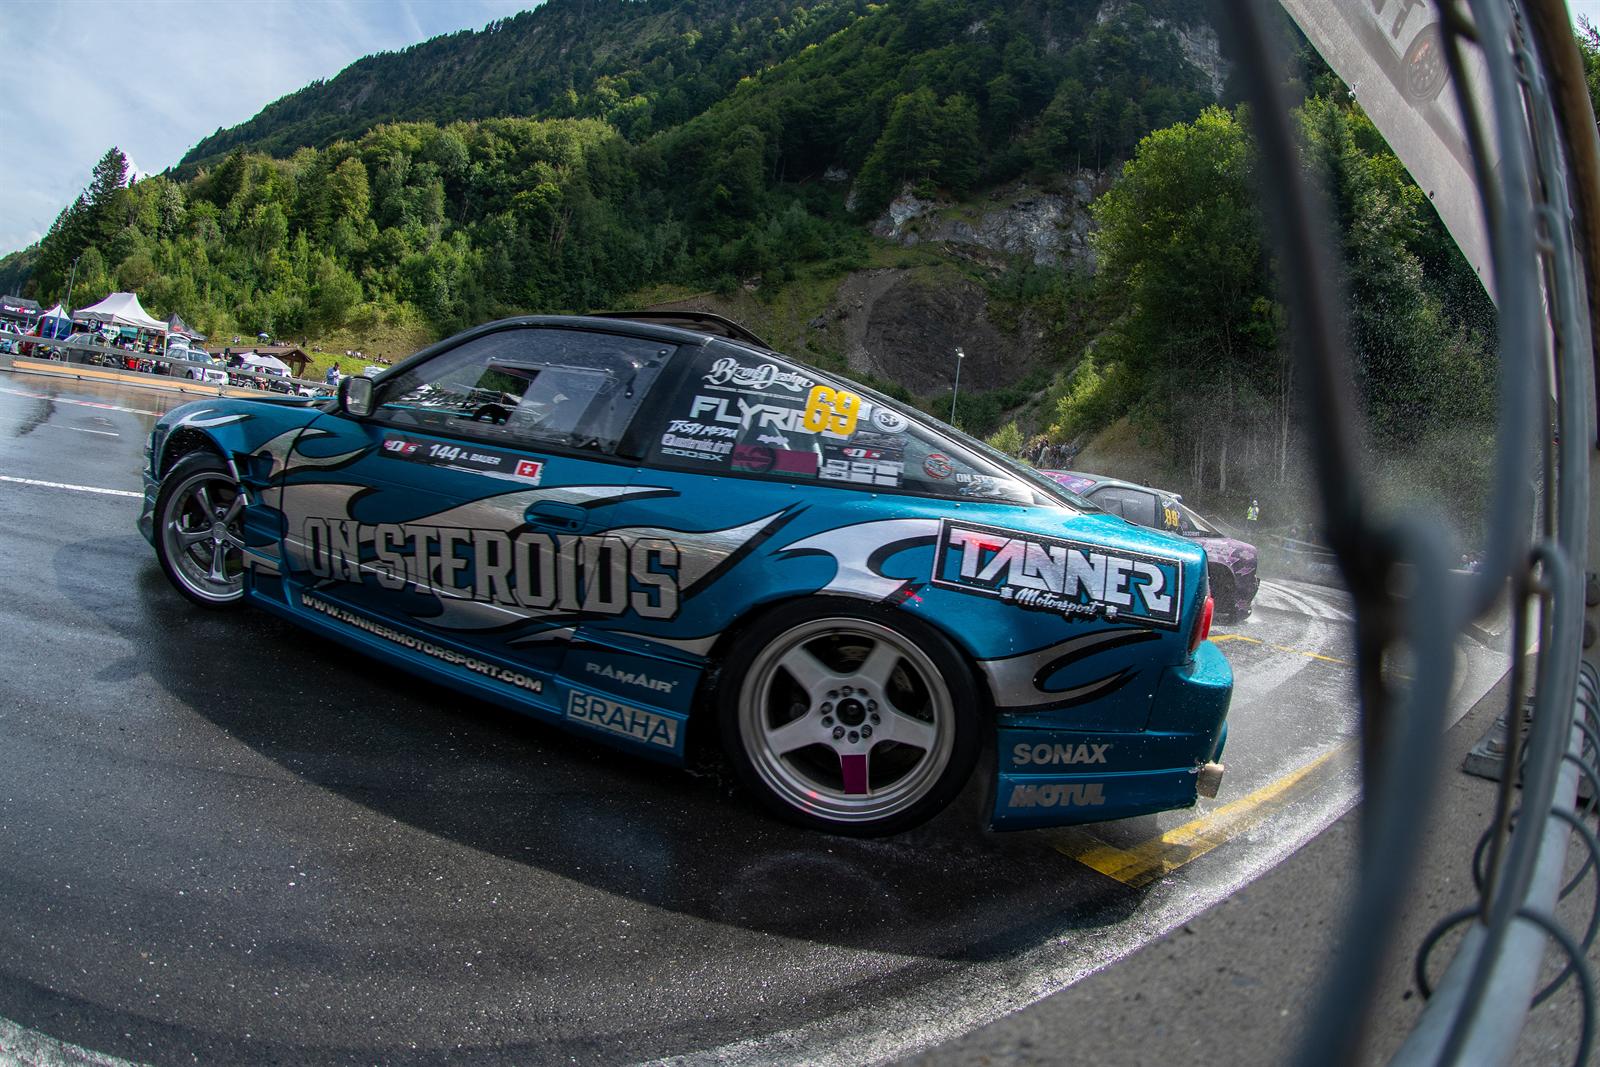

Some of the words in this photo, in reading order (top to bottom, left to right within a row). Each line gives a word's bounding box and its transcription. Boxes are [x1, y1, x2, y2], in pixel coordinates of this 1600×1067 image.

[803, 385, 861, 435] 69
[430, 444, 460, 461] 144
[469, 453, 502, 466] BAUER
[661, 447, 723, 462] 200SX
[303, 516, 362, 583] ON
[375, 522, 681, 621] STEROIDS
[949, 526, 1171, 612] TANNER
[1014, 587, 1104, 616] Motorsport
[301, 593, 542, 693] WWW.TANNERMOTORSPORT.COM
[585, 662, 673, 694] RAMAIR
[570, 691, 673, 745] BRAHA
[1012, 743, 1110, 765] SONAX
[1008, 783, 1106, 808] MOTUL
